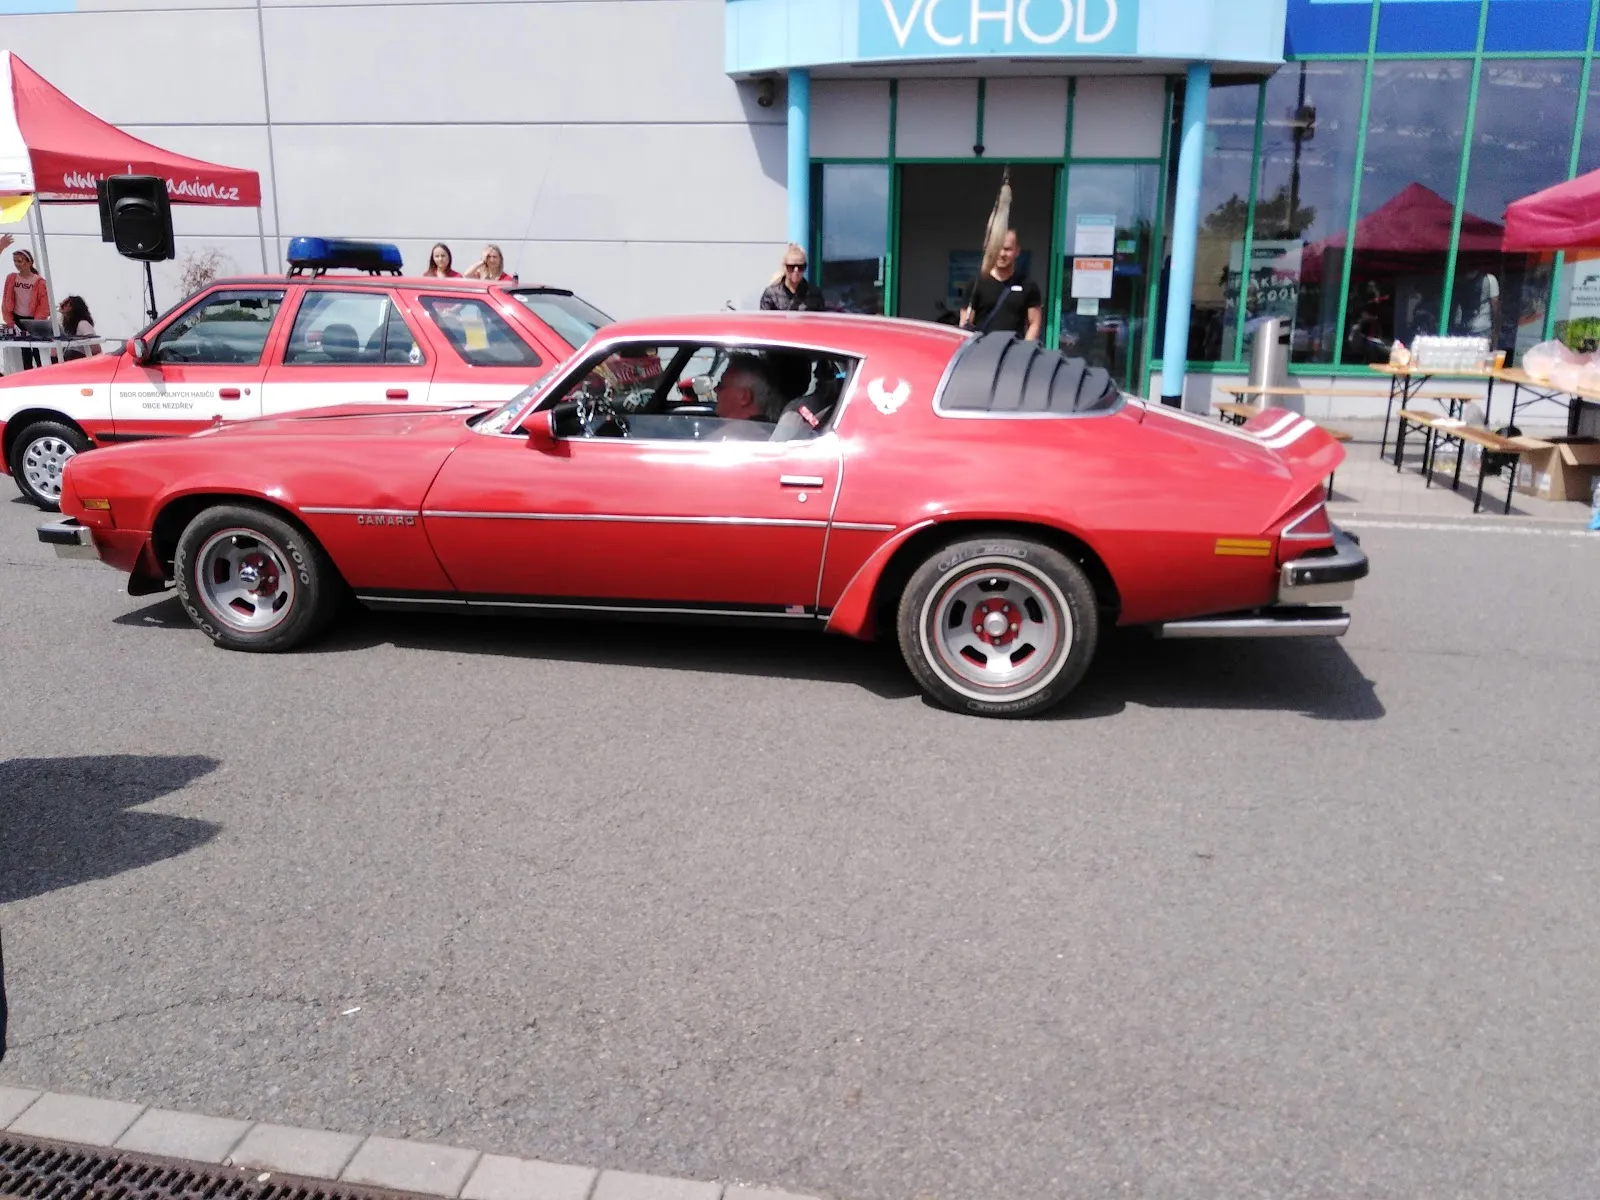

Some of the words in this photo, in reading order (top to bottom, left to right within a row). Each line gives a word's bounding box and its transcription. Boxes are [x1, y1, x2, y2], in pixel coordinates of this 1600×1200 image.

[883, 0, 1118, 49] VCHOD
[142, 402, 161, 410] OBCE
[357, 515, 415, 526] CAMARO
[286, 540, 310, 586] TOYO
